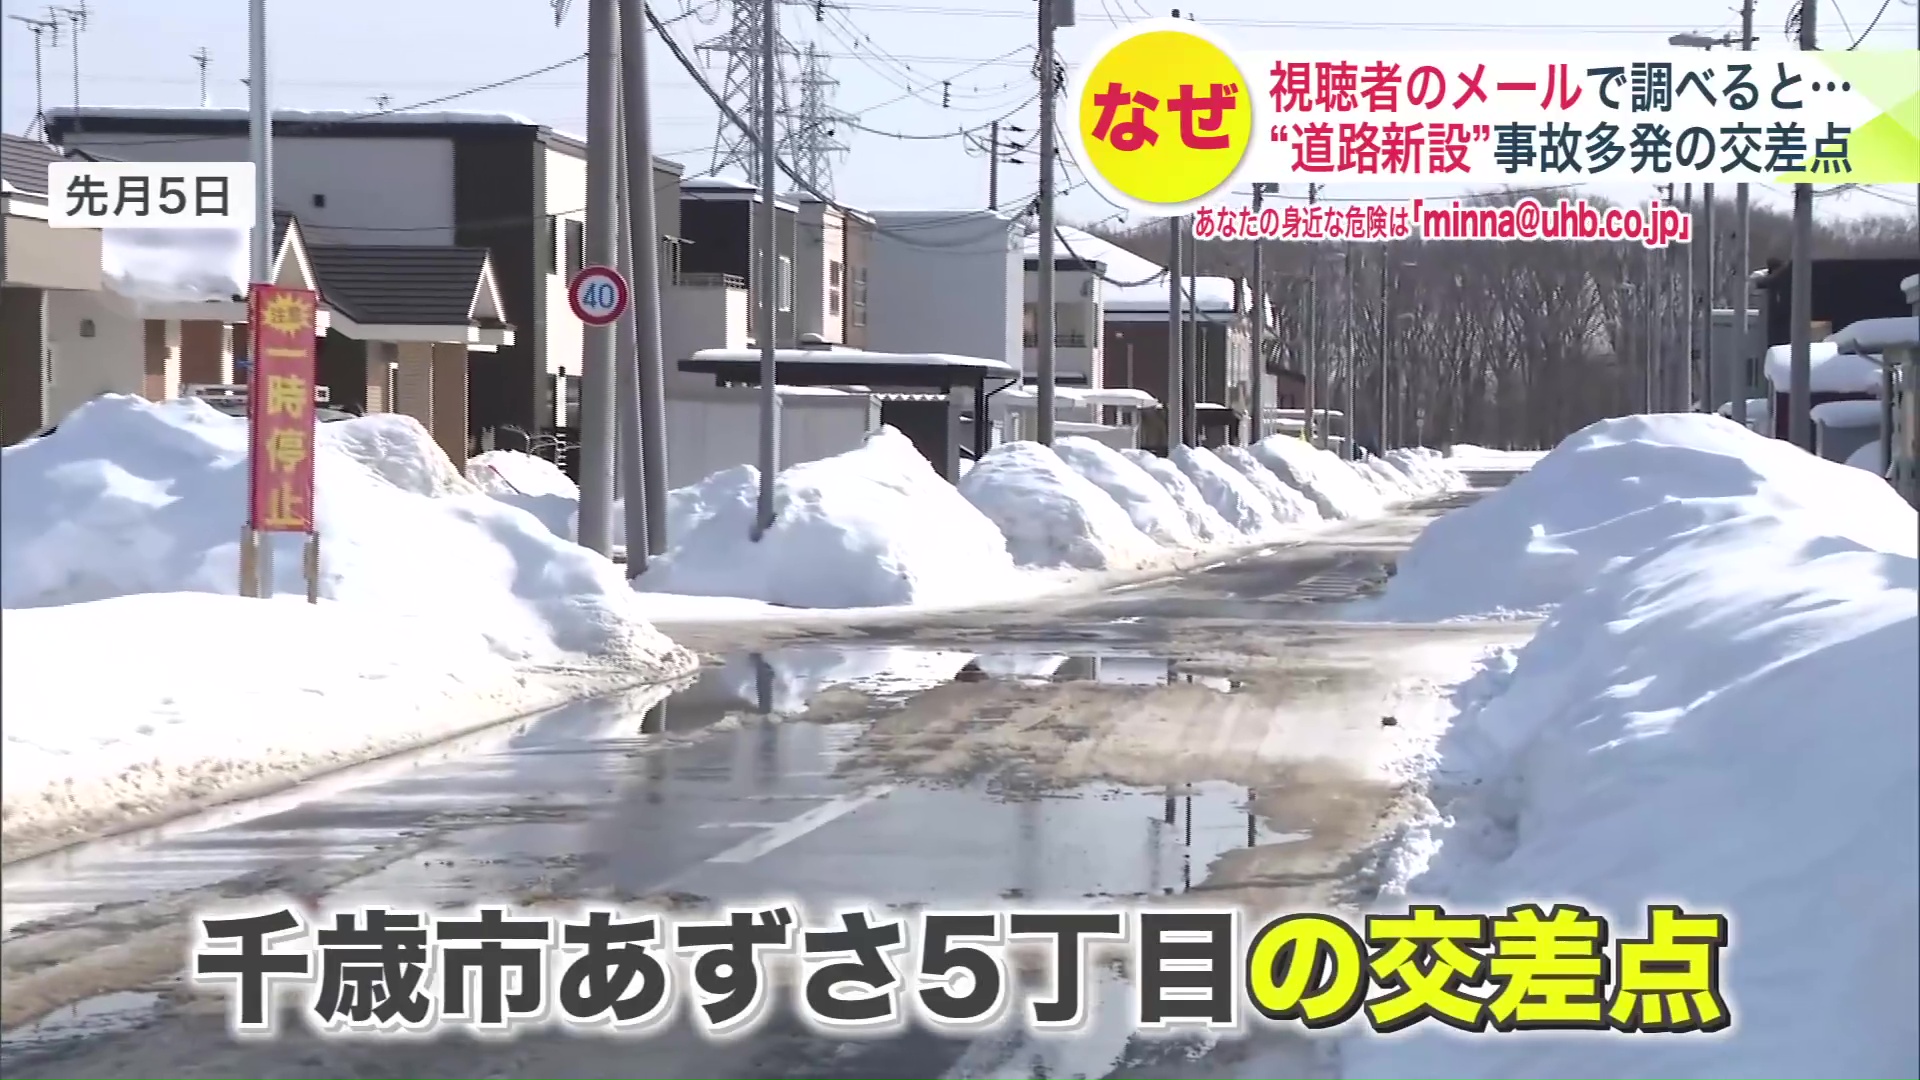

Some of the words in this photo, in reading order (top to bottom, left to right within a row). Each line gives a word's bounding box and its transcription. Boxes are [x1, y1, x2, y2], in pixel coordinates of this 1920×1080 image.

[582, 283, 615, 308] 40
[265, 348, 308, 527] 一時停止
